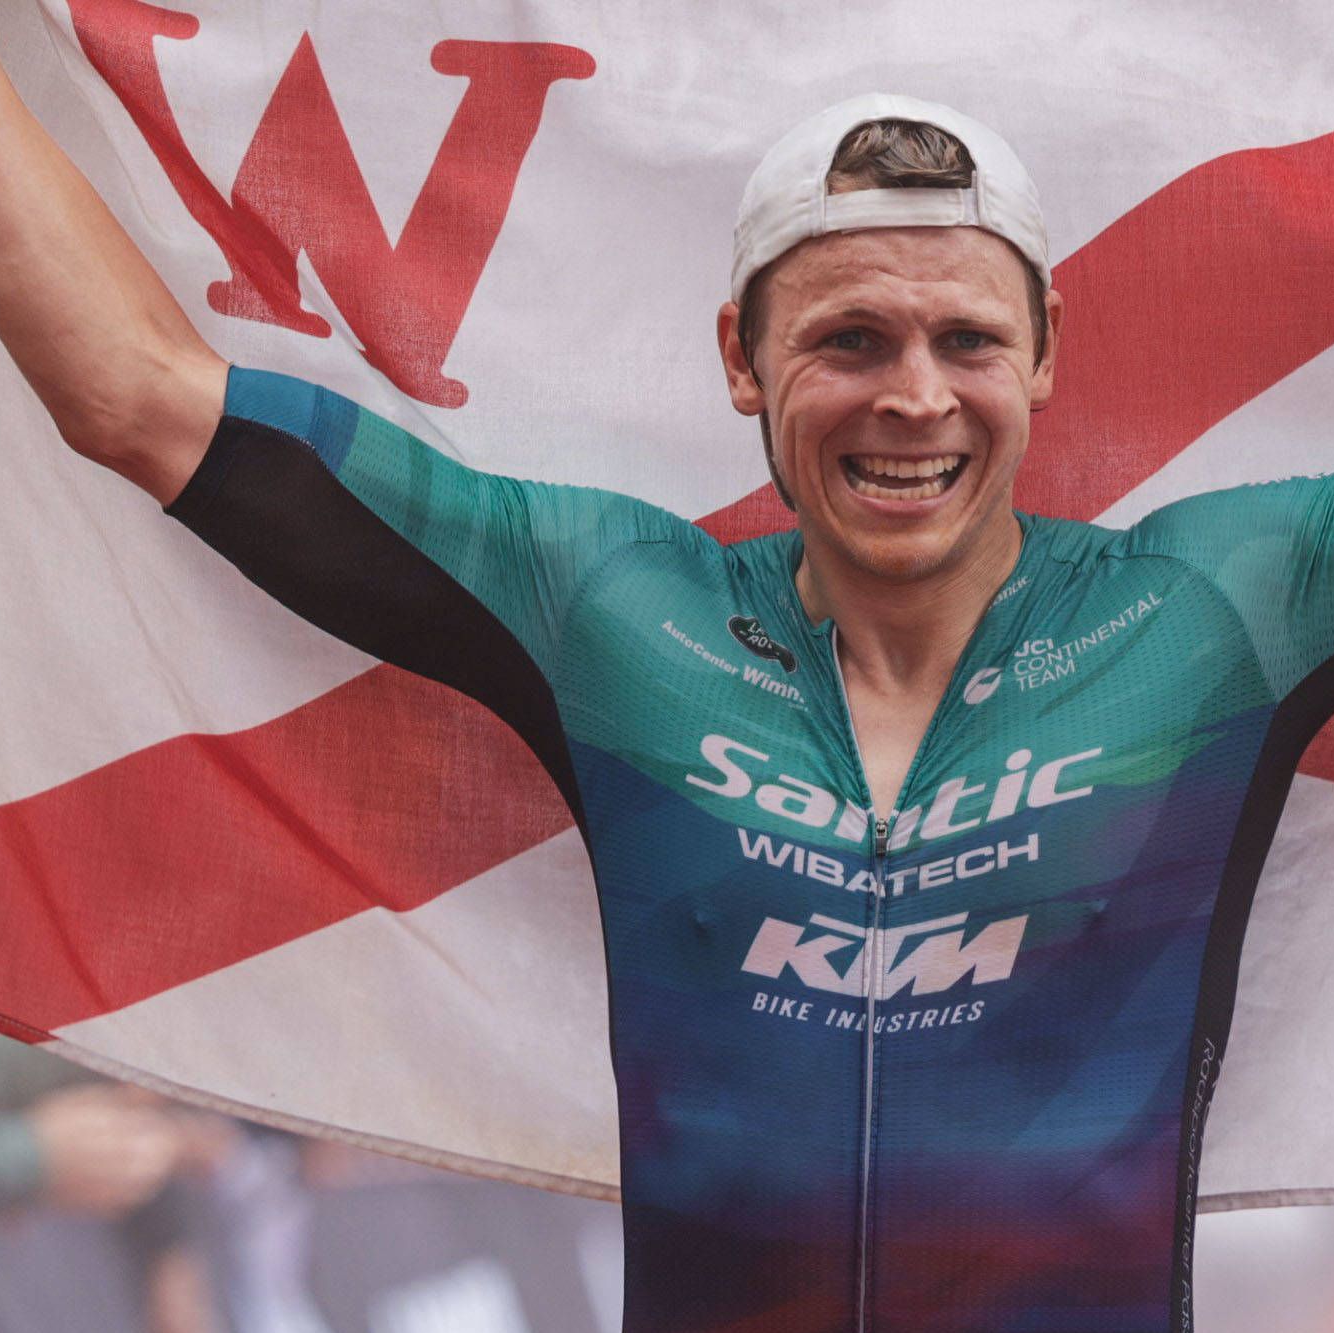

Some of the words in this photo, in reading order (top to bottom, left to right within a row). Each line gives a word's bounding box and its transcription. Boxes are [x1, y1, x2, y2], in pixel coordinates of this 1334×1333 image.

[662, 620, 739, 676] AutoCenter
[1014, 592, 1163, 676] CONTINENTAL
[1014, 638, 1054, 658] JCI
[1017, 659, 1076, 692] TEAM
[685, 734, 1103, 851] Santic
[737, 828, 1040, 898] WIBATECH
[740, 911, 1029, 1001] KTM
[752, 992, 814, 1021] BIKE
